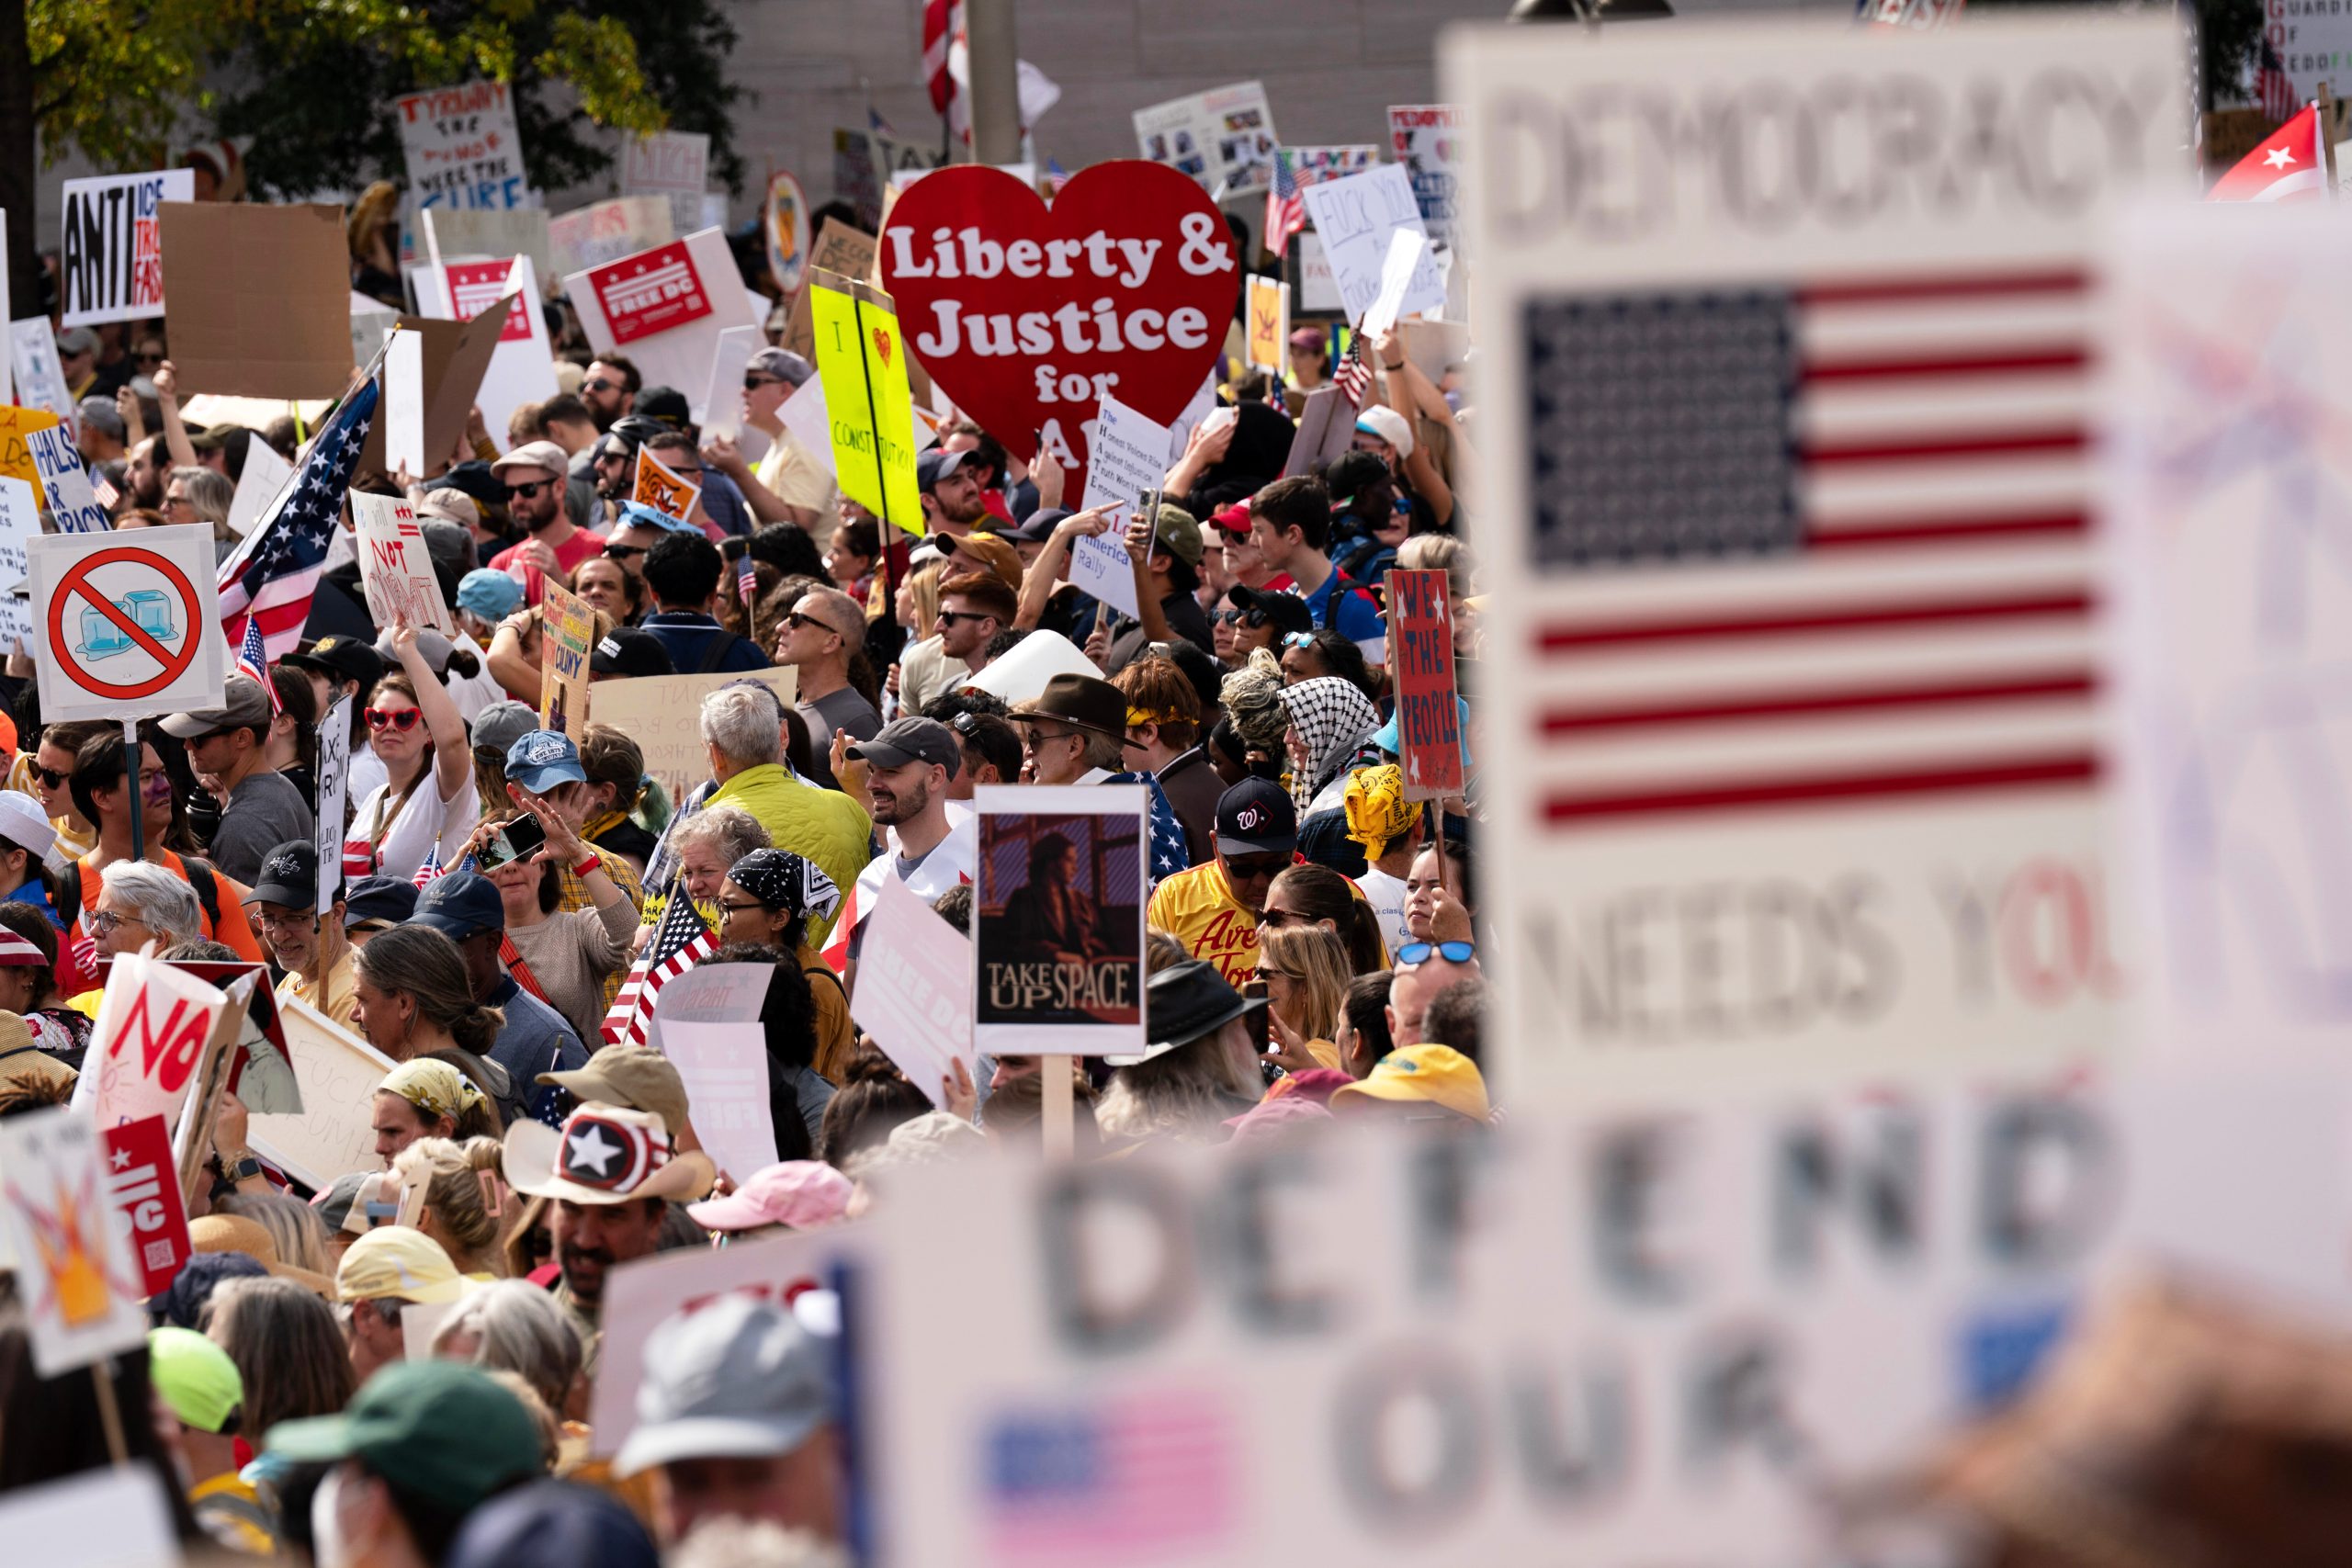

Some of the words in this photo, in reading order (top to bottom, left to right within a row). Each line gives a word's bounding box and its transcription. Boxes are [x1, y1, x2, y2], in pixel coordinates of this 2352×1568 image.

[1302, 151, 1350, 167] LOVE
[1490, 66, 2176, 244] DEMOCRACY
[1317, 189, 1375, 246] FUCK
[65, 186, 134, 312] ANTI
[887, 227, 1162, 288] Liberty
[1178, 212, 1234, 276] &
[608, 287, 663, 319] FREE
[662, 276, 695, 300] DC
[832, 321, 842, 353] I
[918, 298, 1208, 356] Justice
[1035, 365, 1119, 402] for
[1103, 409, 1117, 424] The
[834, 420, 913, 472] CONSTTUTION
[1126, 442, 1148, 461] Voices
[370, 537, 408, 575] NOT
[1078, 549, 1106, 580] Rally
[1081, 535, 1128, 566] America
[1402, 573, 1432, 619] WE
[1405, 628, 1443, 675] THE
[1402, 691, 1457, 747] PEOPLE
[1238, 808, 1258, 830] W
[1523, 871, 1898, 1047] NEEDS
[986, 963, 1053, 987] TAKE
[1053, 963, 1131, 1010] SPACE
[989, 985, 1054, 1010] UP
[294, 1040, 372, 1112] FUCK
[1038, 1090, 2126, 1359] DEFEND
[1329, 1320, 1812, 1548] OUR
